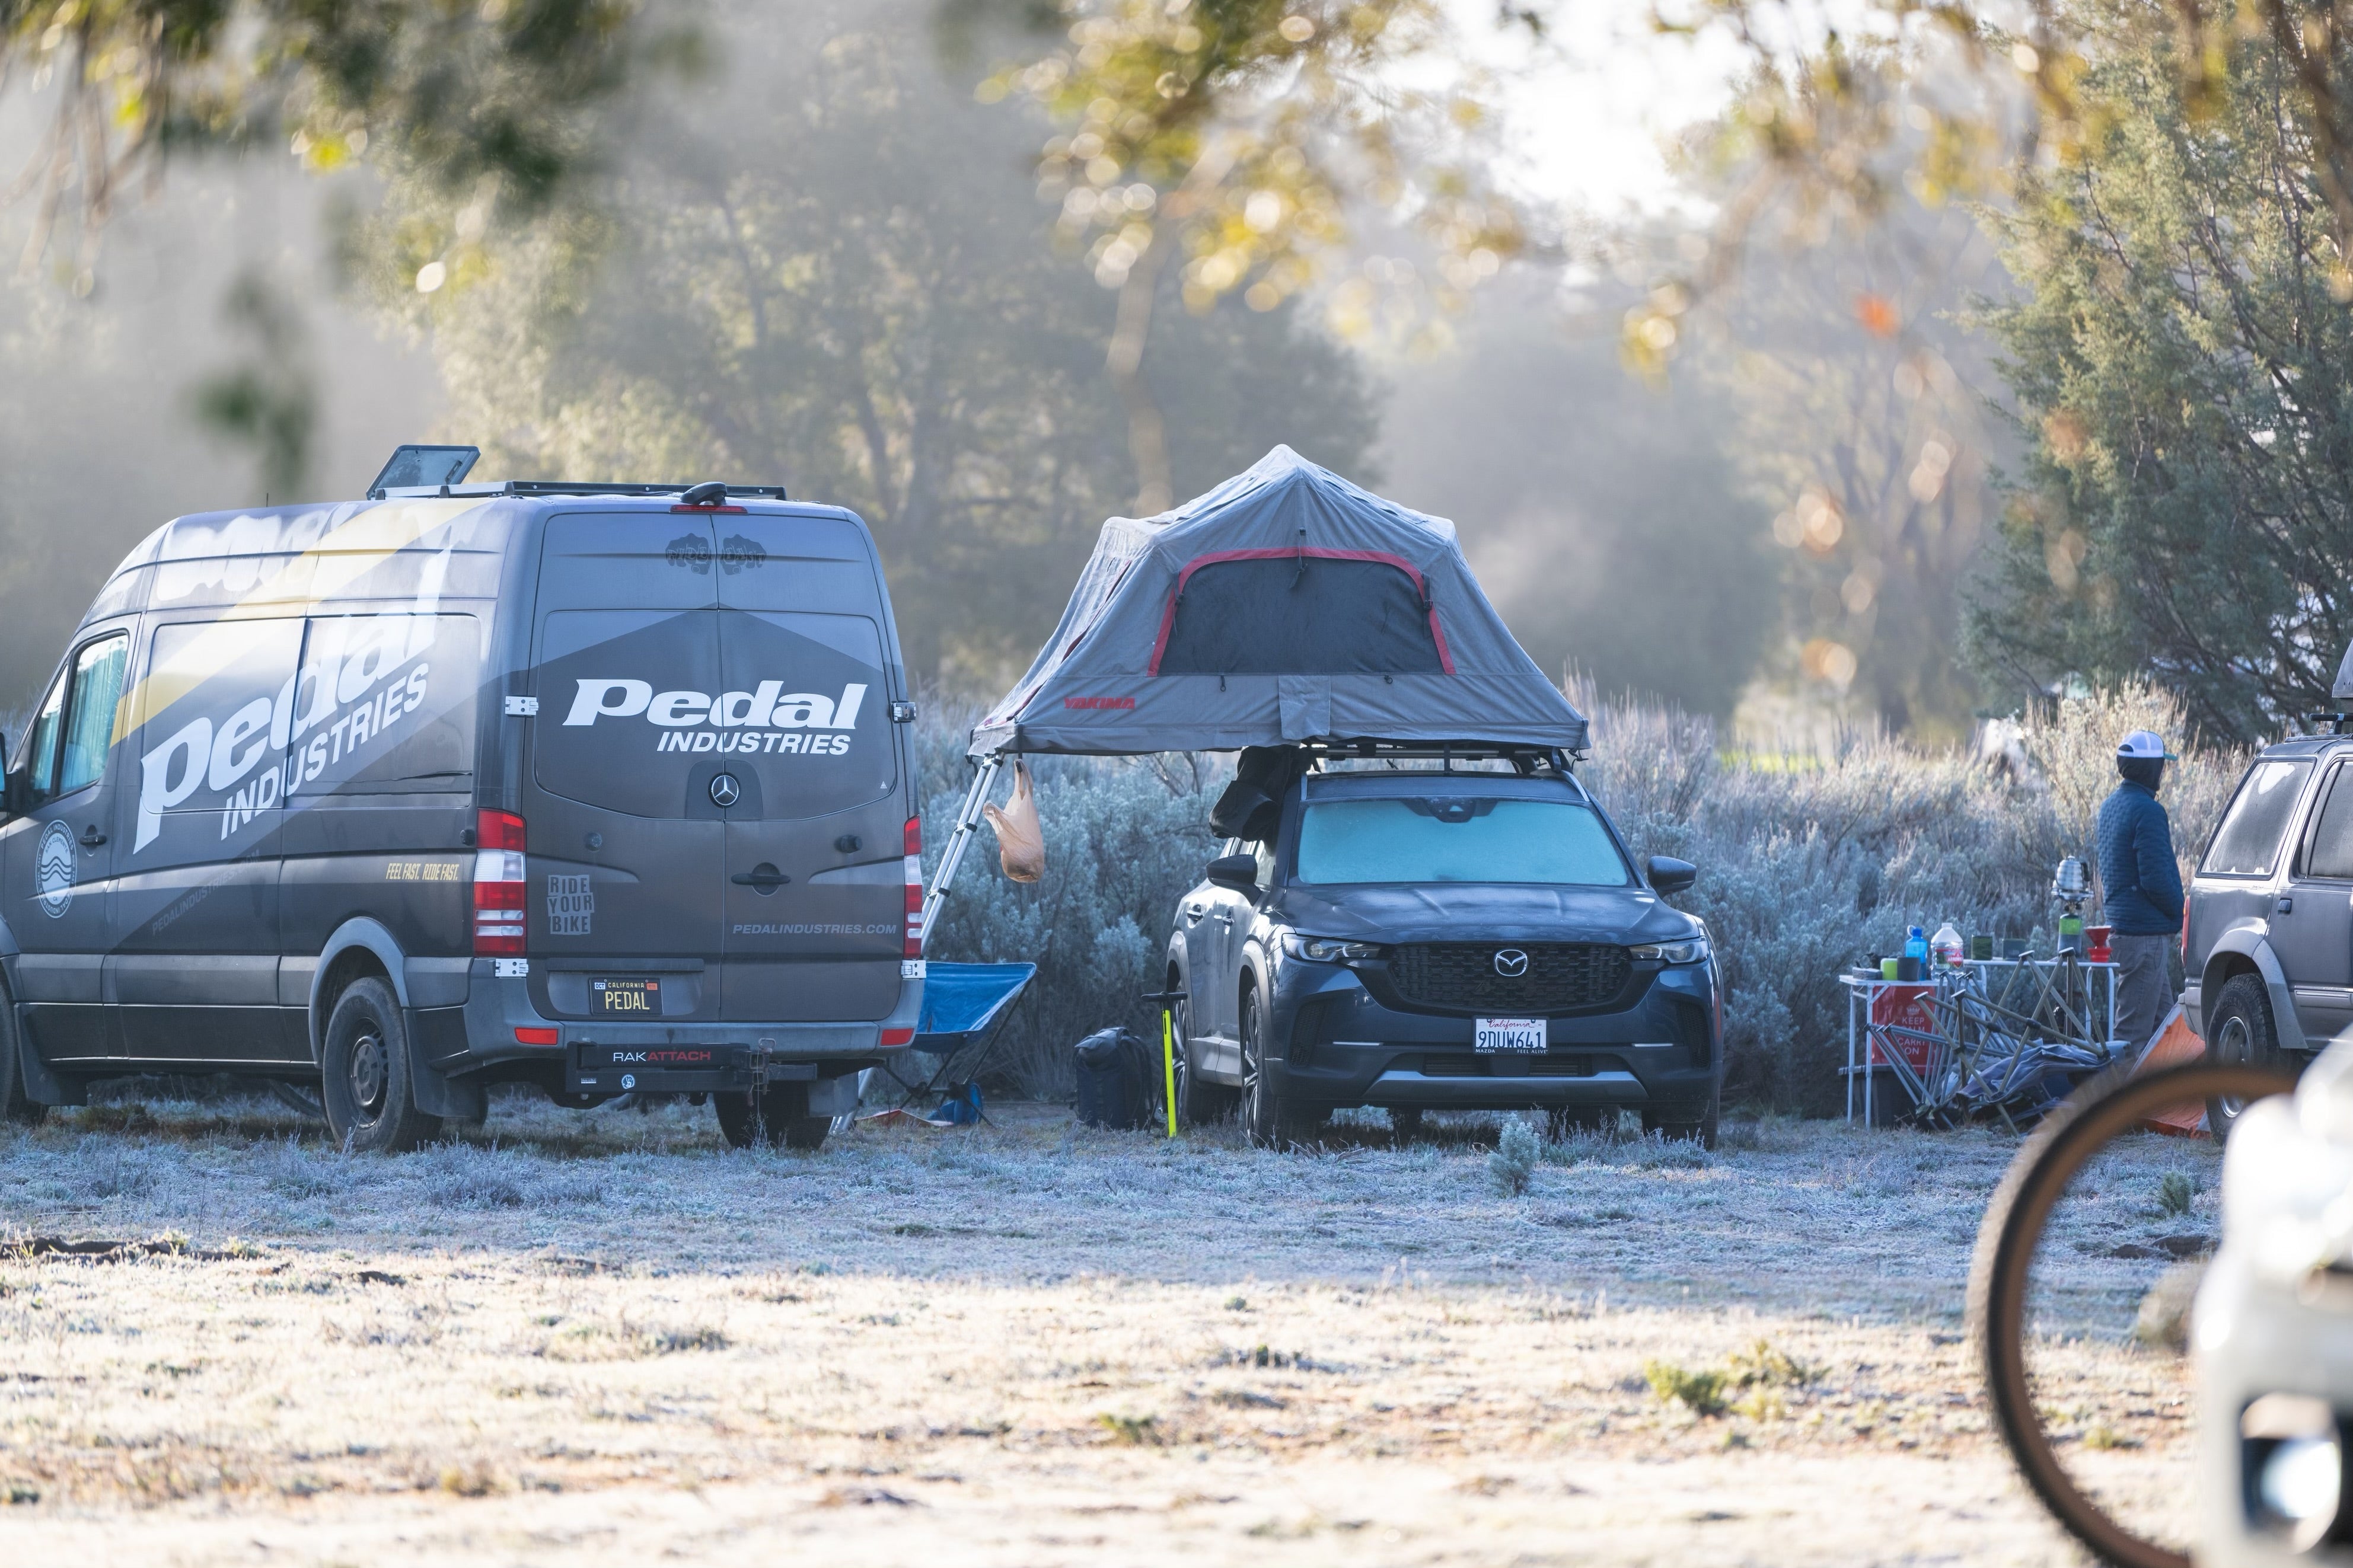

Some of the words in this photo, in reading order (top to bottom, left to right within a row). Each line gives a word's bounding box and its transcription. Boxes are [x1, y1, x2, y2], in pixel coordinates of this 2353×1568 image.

[563, 679, 868, 730] Pedal
[1064, 697, 1135, 709] YAKIMA
[220, 663, 429, 841] INDUSTRIES
[656, 732, 851, 755] INDUSTRIES
[40, 828, 53, 850] PEDAL
[53, 823, 74, 851] INDUSTRIES
[386, 863, 402, 880] FEEL
[402, 863, 421, 880] FAST.
[422, 864, 441, 880] RIDE
[440, 864, 459, 880] FAST.
[550, 877, 587, 894] RIDE
[549, 895, 592, 914] YOUR
[552, 916, 588, 933] BIKE
[732, 924, 897, 934] PEDALINDUSTRIES.COM
[605, 991, 650, 1010] PEDAL
[1489, 1018, 1535, 1030] California
[1902, 1017, 1925, 1025] KEEP
[1478, 1032, 1544, 1048] 9DUW641
